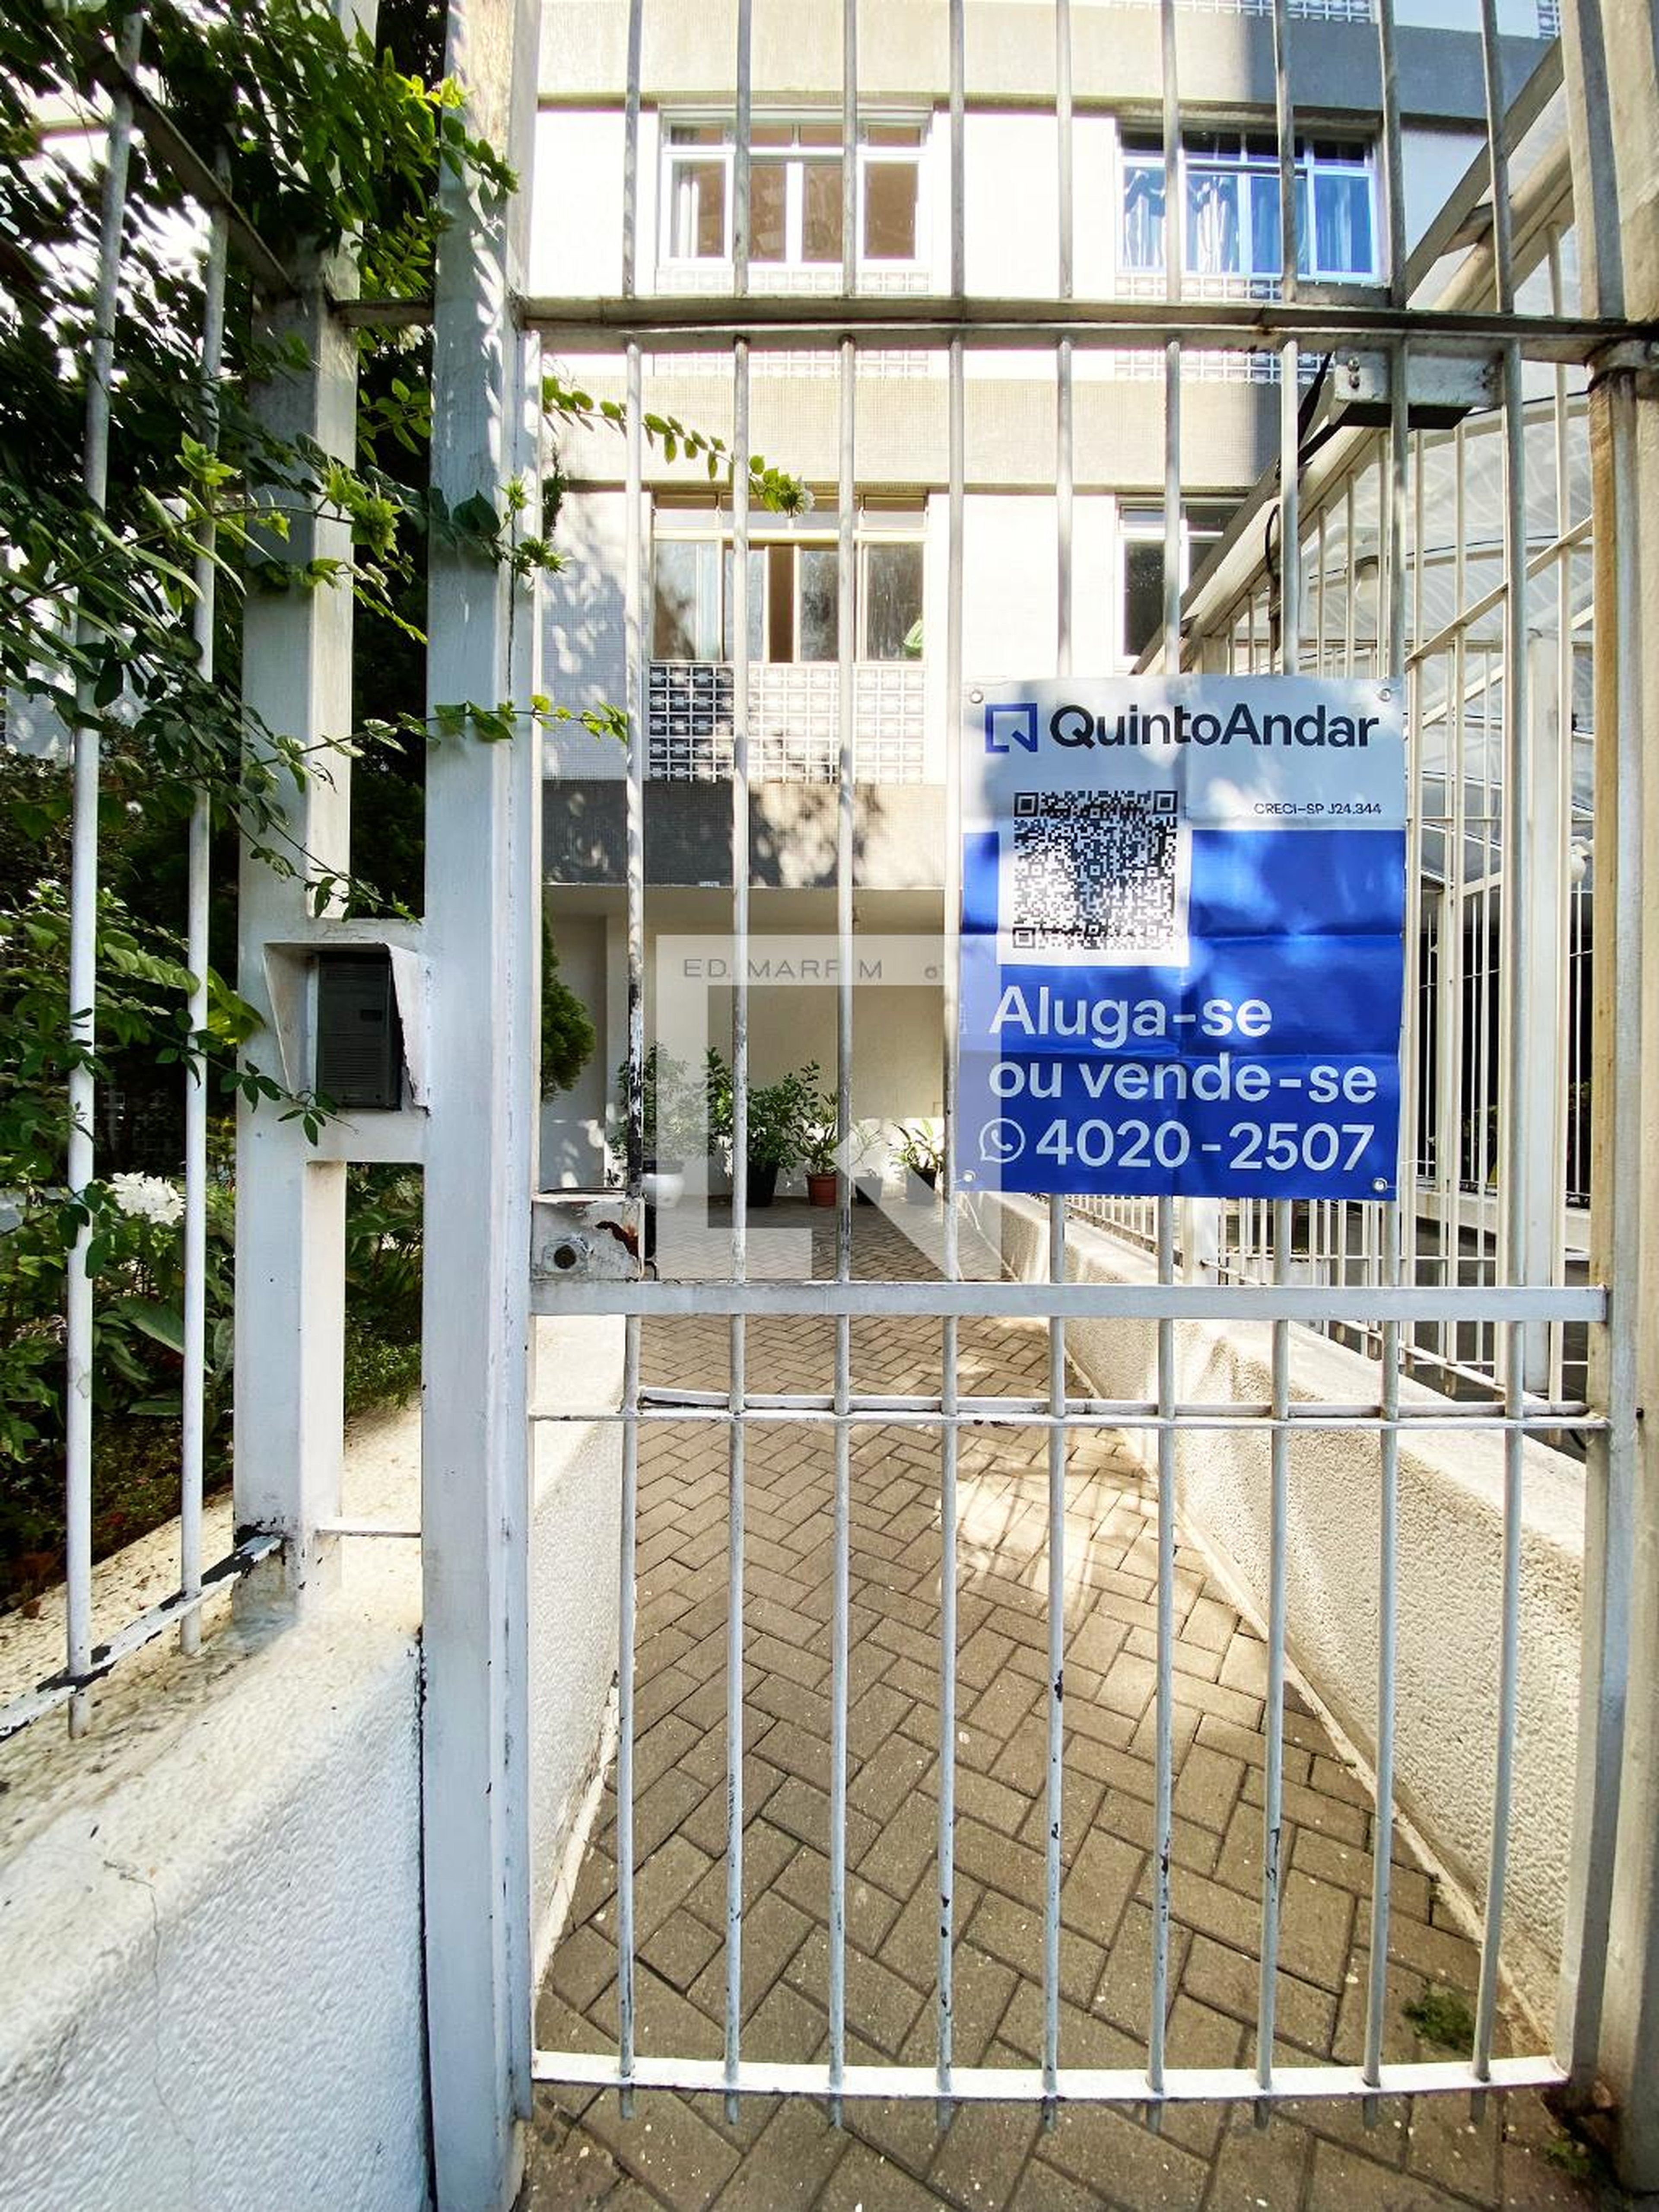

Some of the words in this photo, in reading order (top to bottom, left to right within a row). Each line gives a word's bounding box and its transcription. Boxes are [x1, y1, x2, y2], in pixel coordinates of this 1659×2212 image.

[1049, 703, 1380, 749] QuintoAndar
[1253, 803, 1324, 814] CRECI-SP
[1327, 803, 1382, 814] J24.344
[747, 959, 882, 978] MARFM
[988, 985, 1272, 1049] Aluga-se
[988, 1060, 1062, 1098] ou
[1079, 1052, 1377, 1104] vende-se
